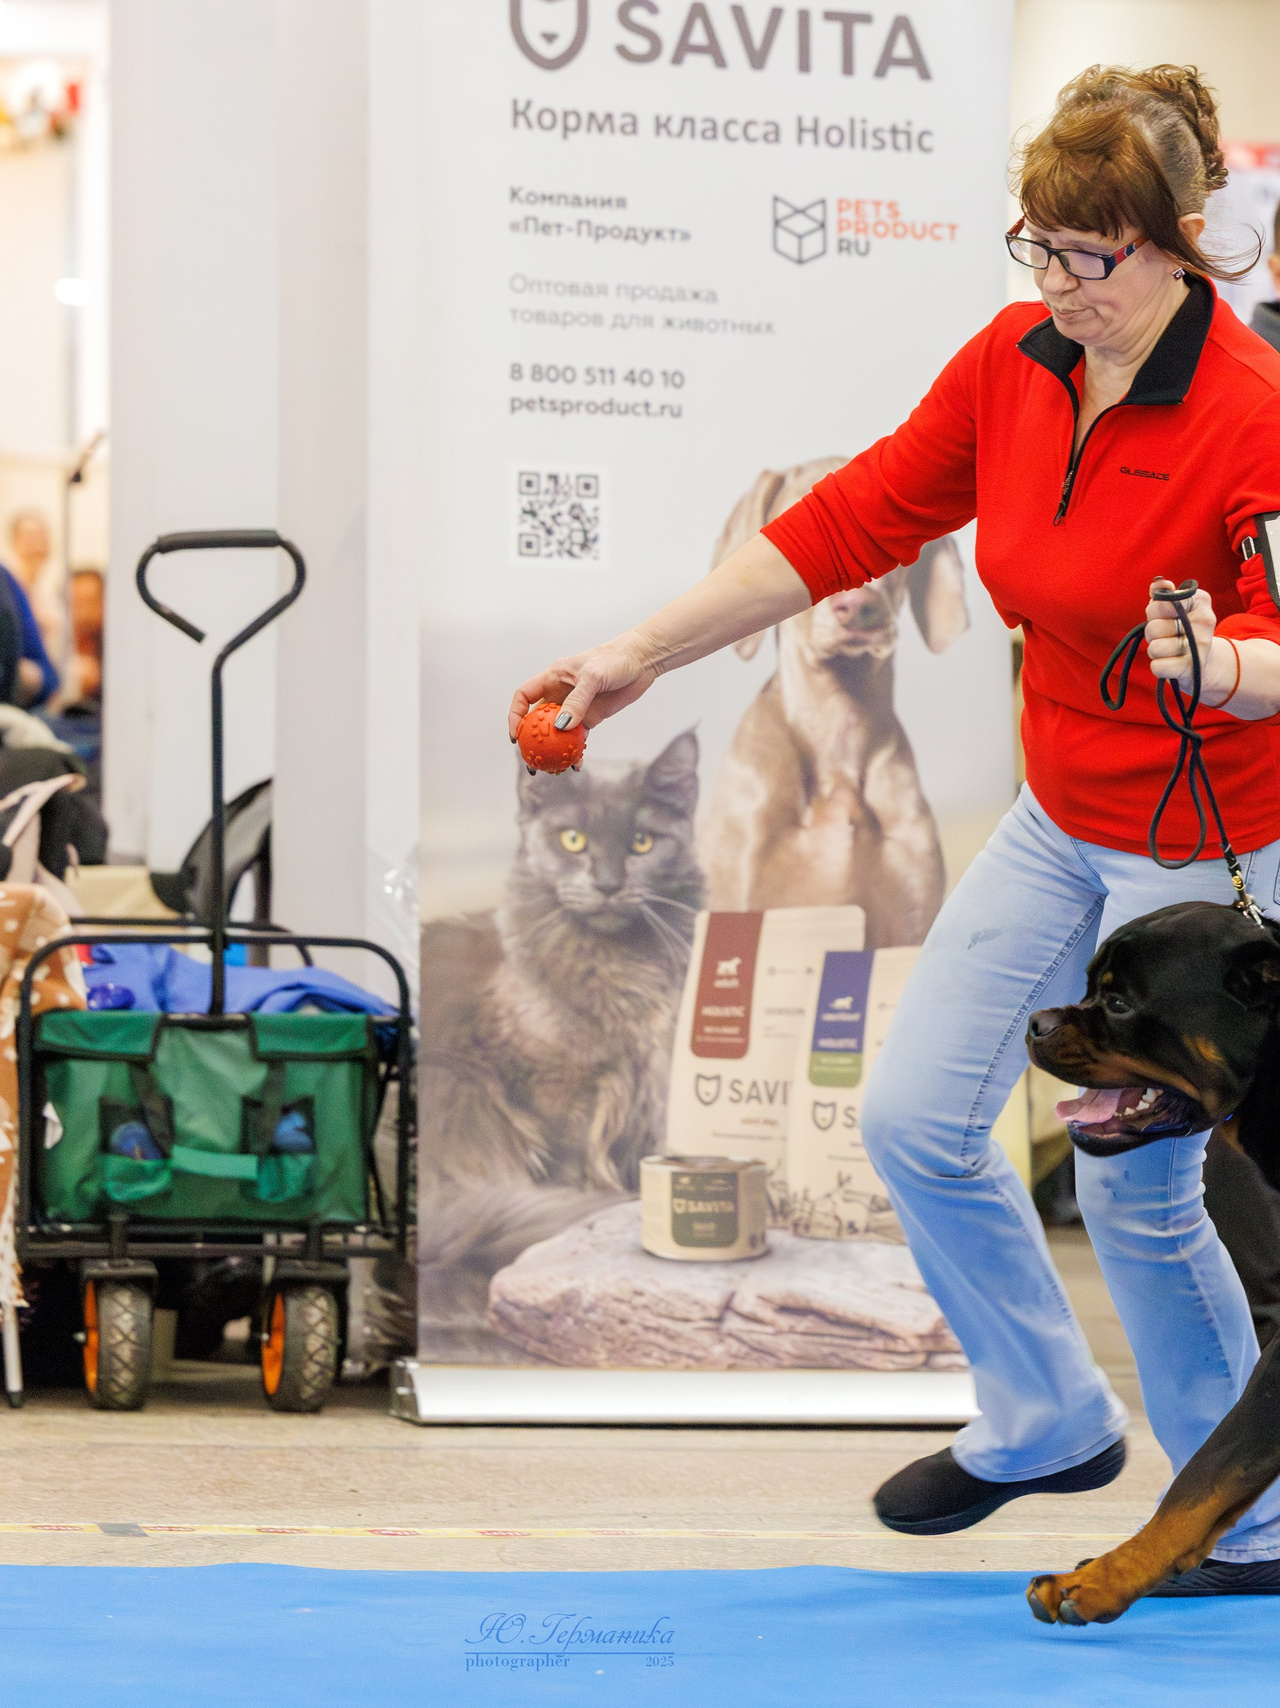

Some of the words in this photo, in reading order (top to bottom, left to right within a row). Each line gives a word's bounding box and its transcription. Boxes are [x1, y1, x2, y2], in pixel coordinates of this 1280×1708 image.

[615, 0, 933, 82] SAVITA
[511, 98, 638, 140] Корма
[654, 112, 781, 145] класса
[796, 115, 934, 154] Holistic
[510, 187, 627, 209] Компания
[836, 197, 900, 220] PETS
[509, 216, 691, 245] «Пет-Продукт»
[837, 218, 959, 242] PRODUCT
[837, 237, 870, 257] RU
[509, 273, 608, 298] Оптовая
[616, 281, 719, 305] продажа
[509, 307, 604, 331] товаров
[611, 311, 653, 332] для
[662, 316, 775, 336] животных
[510, 363, 523, 381] 8
[530, 363, 577, 384] 800
[585, 366, 615, 386] 511
[623, 368, 654, 388] 40
[661, 370, 686, 389] 10
[510, 396, 682, 420] petsproduct.ru
[728, 1079, 791, 1106] SAVI
